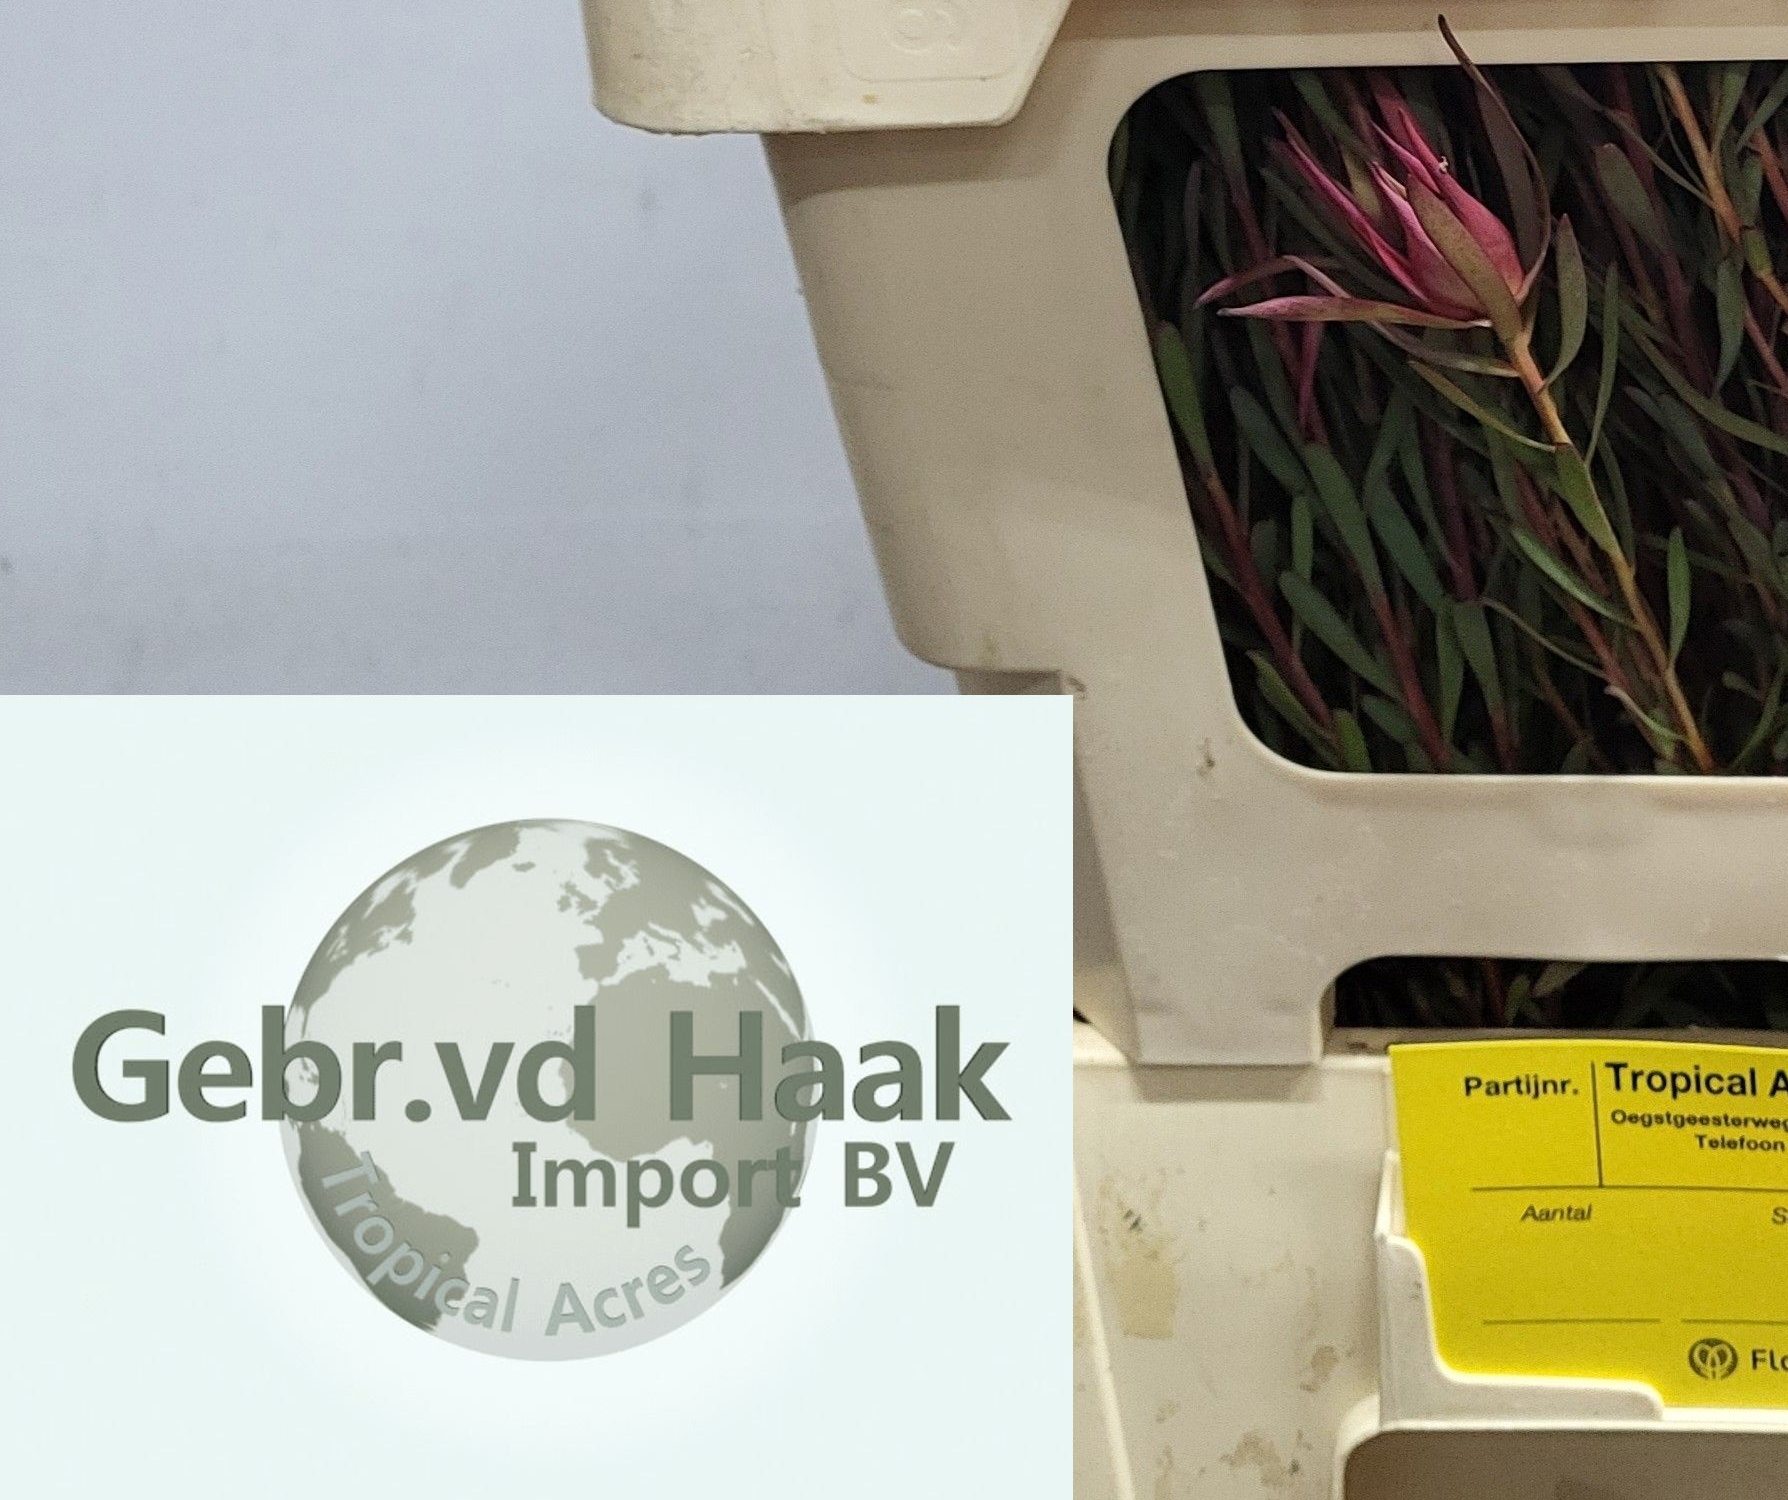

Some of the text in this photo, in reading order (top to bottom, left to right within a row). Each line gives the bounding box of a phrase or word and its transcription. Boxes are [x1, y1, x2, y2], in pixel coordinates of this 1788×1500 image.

[1464, 1074, 1579, 1100] Partijnr.
[1604, 1062, 1757, 1100] Tropical
[1695, 1134, 1785, 1153] Telefoon
[1520, 1203, 1593, 1222] Aantal
